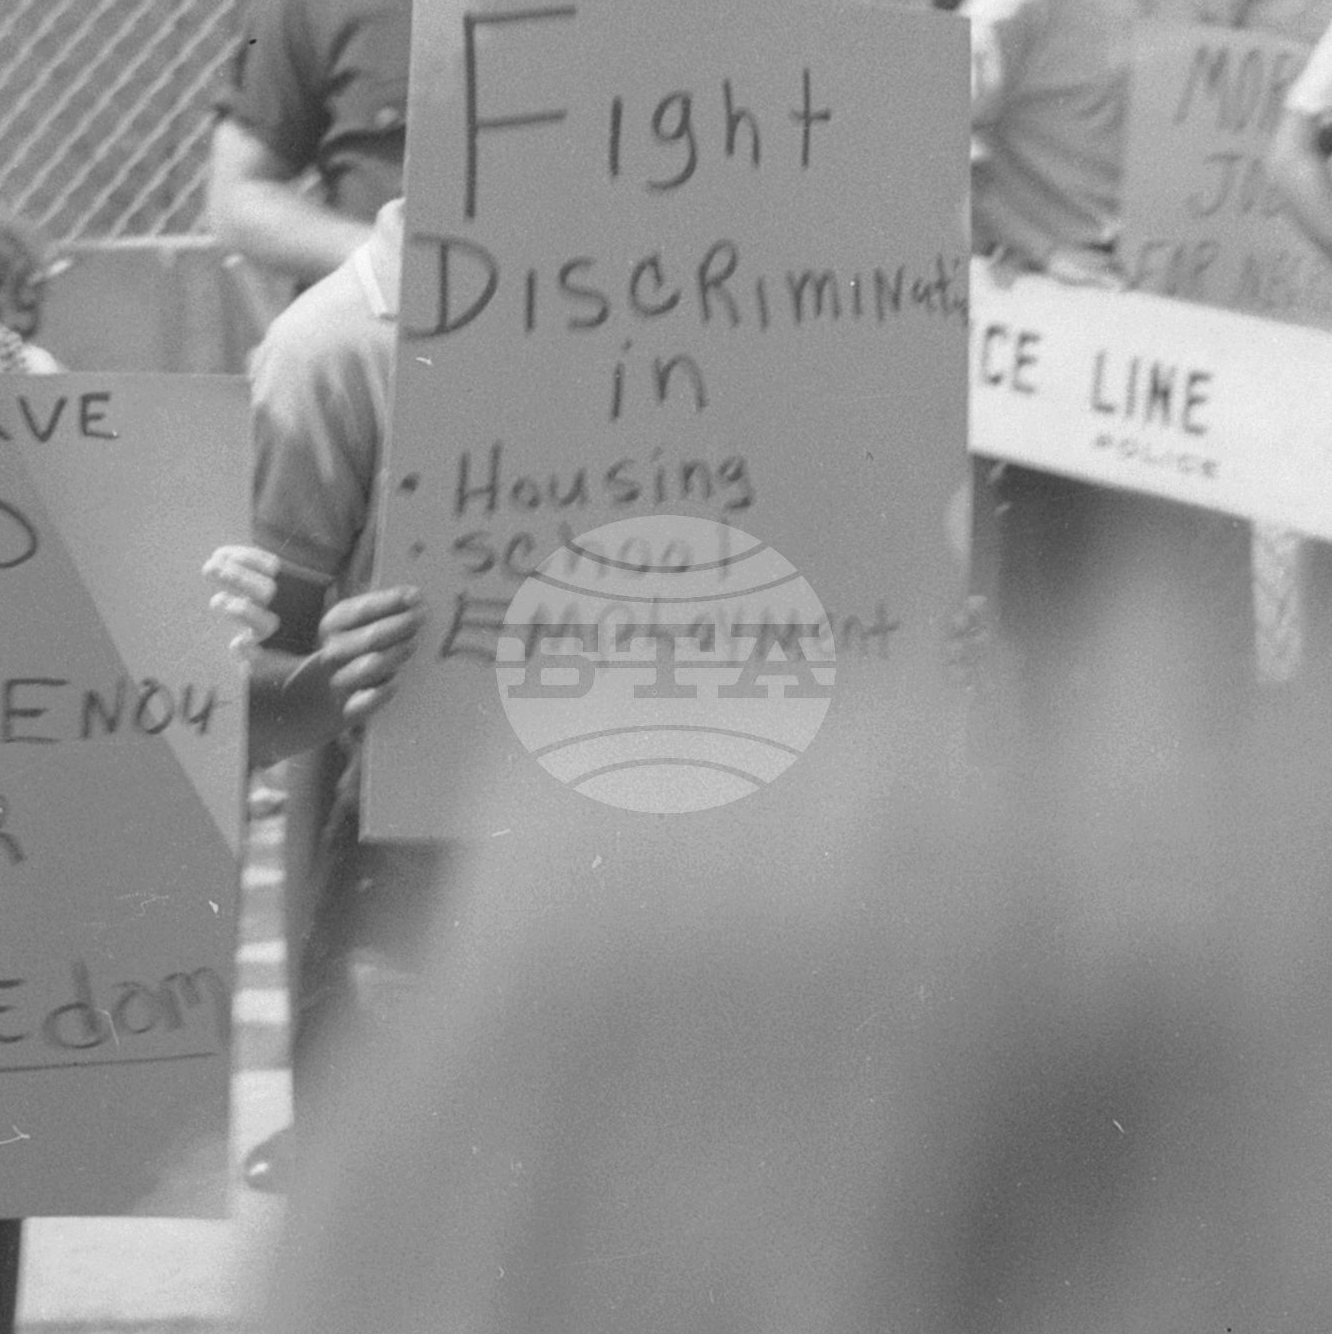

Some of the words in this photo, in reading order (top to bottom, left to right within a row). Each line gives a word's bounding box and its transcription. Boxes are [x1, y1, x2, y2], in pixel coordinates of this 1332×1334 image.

[1173, 41, 1301, 133] MOR
[610, 339, 709, 423] in
[1090, 350, 1214, 436] LINE
[452, 439, 755, 519] Housing
